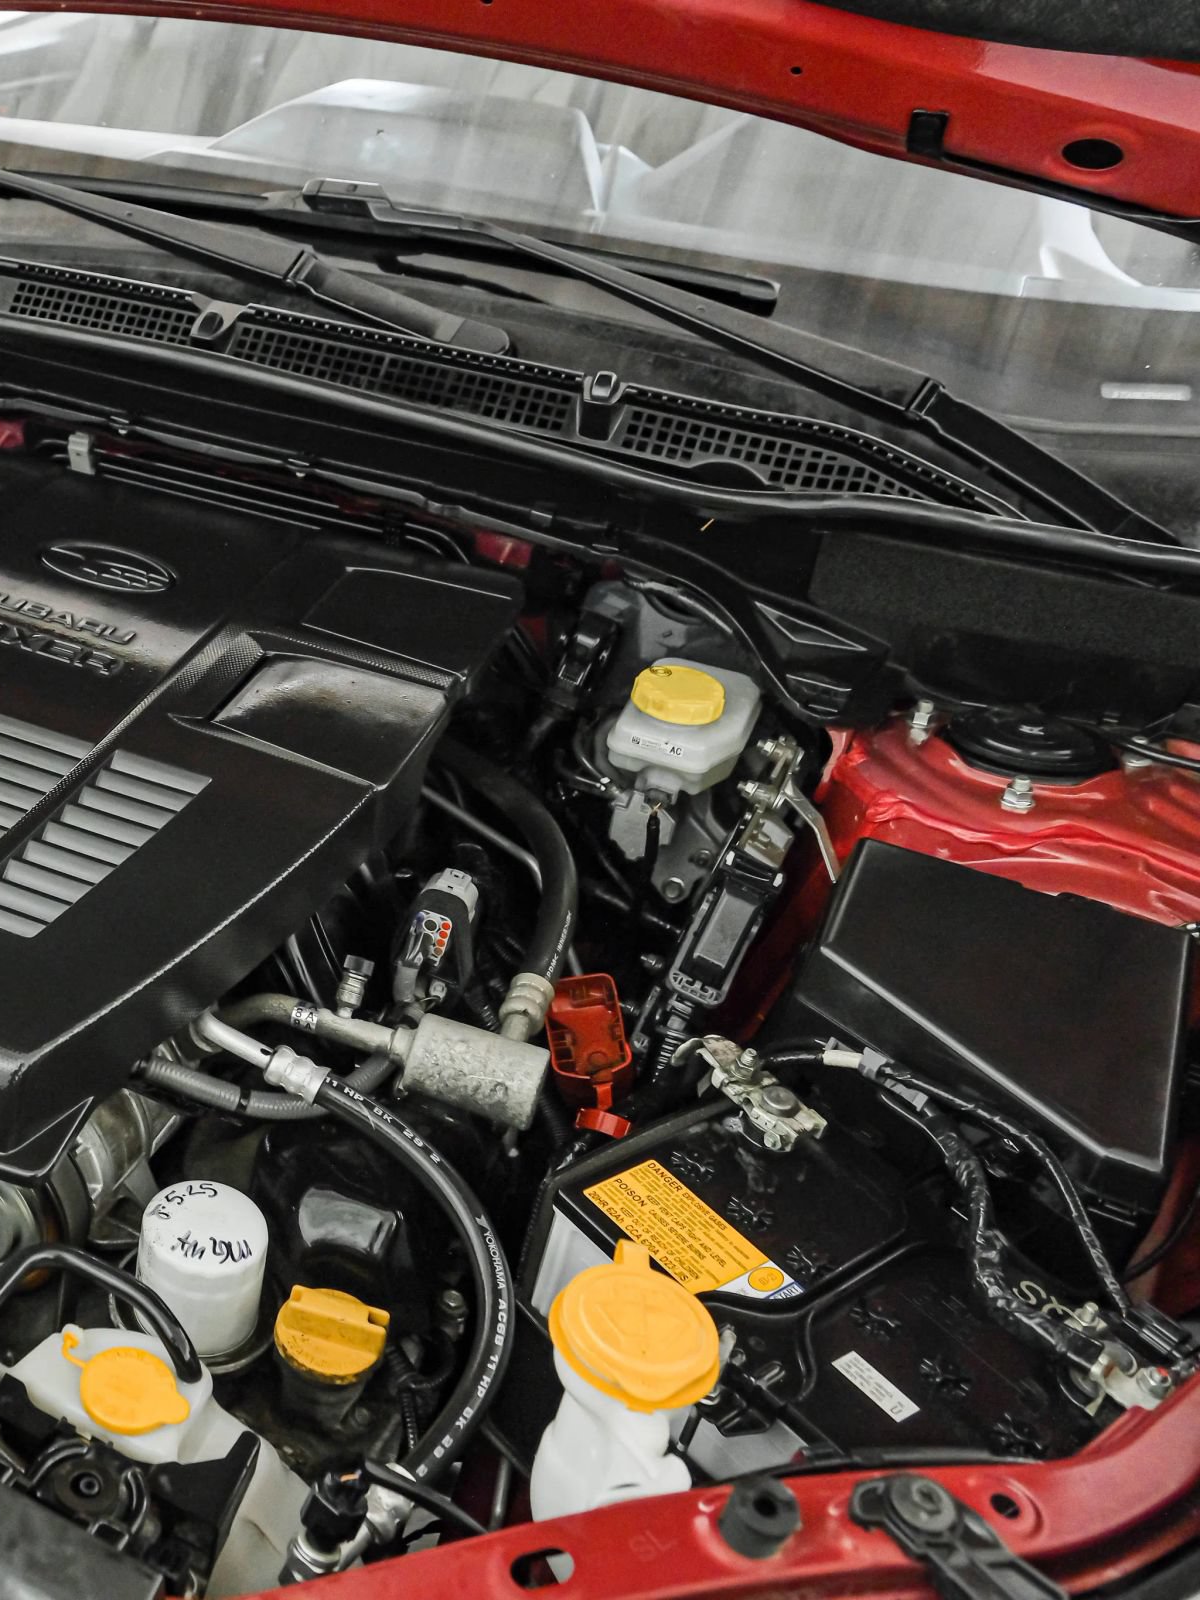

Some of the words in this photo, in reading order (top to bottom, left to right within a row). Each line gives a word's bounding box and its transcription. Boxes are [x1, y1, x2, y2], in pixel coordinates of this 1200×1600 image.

[669, 746, 682, 756] AC
[324, 1075, 339, 1088] 11
[343, 1085, 365, 1102] HP
[372, 1106, 394, 1124] BK
[402, 1127, 425, 1148] 29
[429, 1152, 441, 1164] 2
[613, 1178, 648, 1208] POISON
[647, 1162, 683, 1192] DANGER
[708, 1215, 728, 1231] GASES
[625, 1224, 643, 1240] CCA
[483, 1230, 507, 1290] YOKOHAMA
[487, 1353, 499, 1371] 11
[477, 1375, 492, 1400] HP
